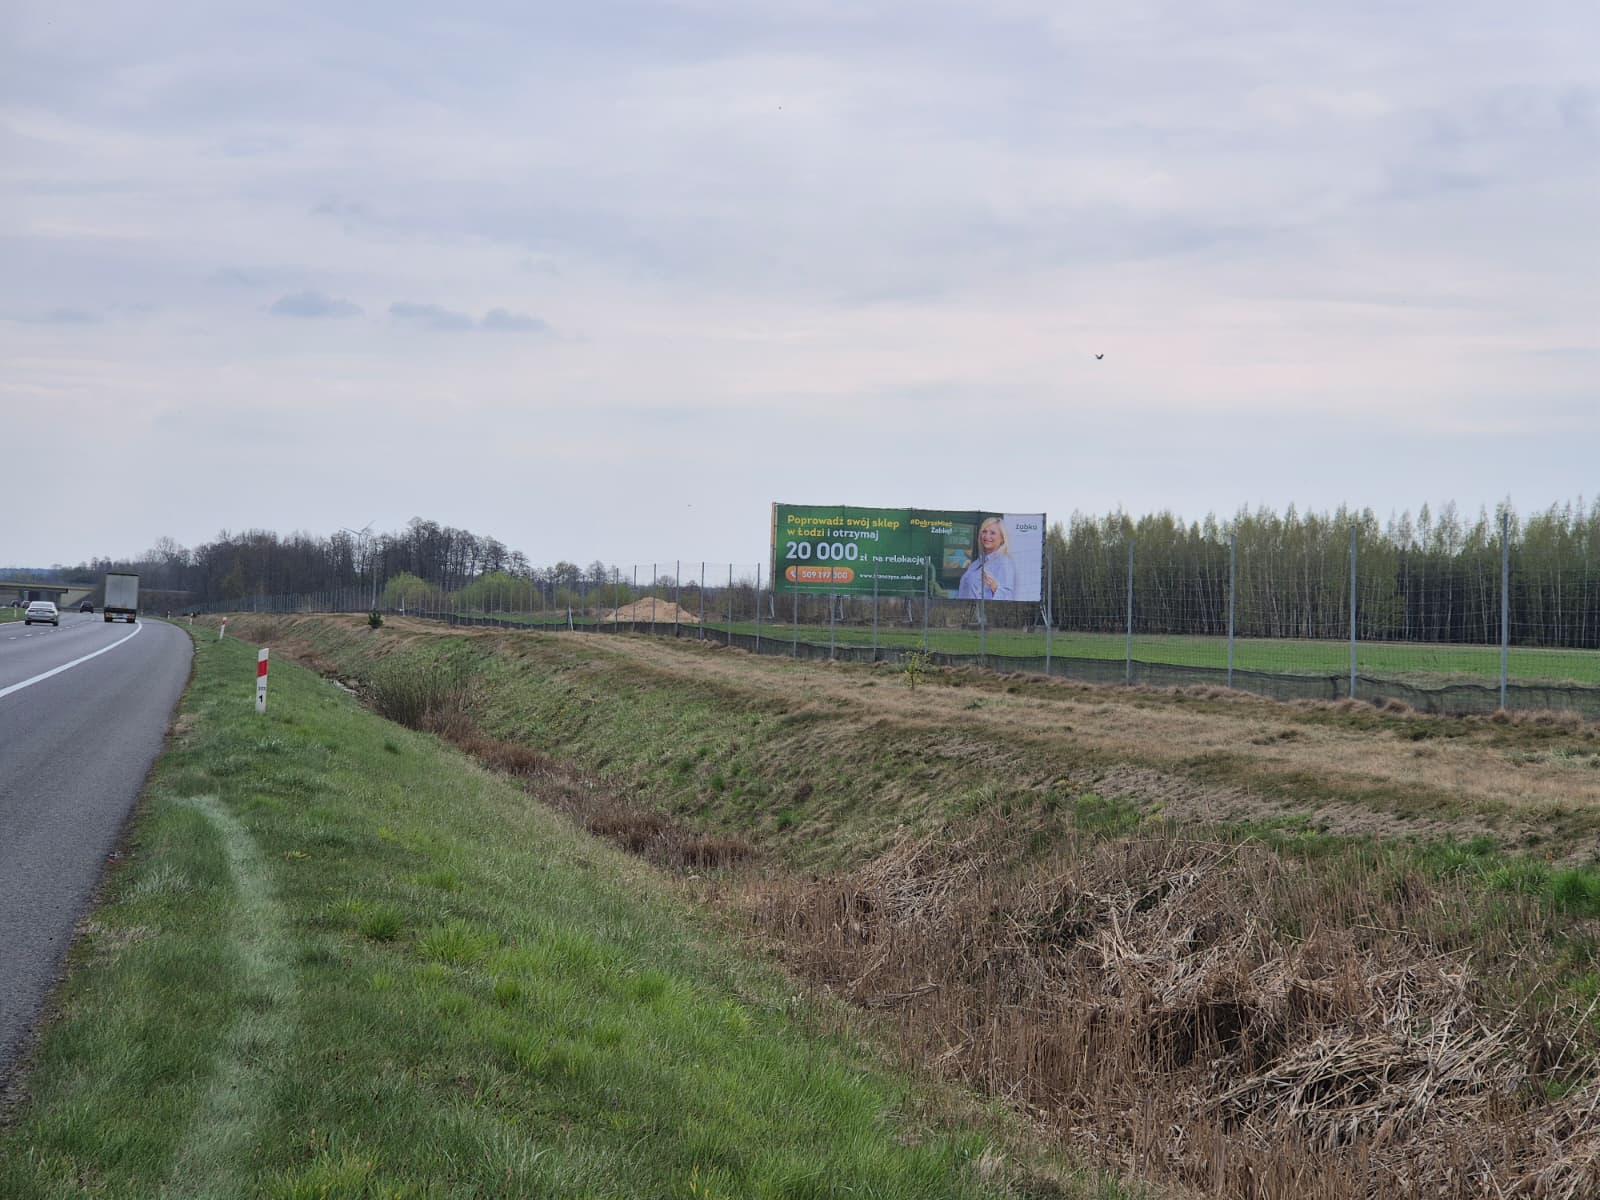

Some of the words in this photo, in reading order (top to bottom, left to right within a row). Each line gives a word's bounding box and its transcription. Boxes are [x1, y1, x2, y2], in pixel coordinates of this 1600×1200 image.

[787, 514, 844, 527] Poprowadź
[847, 517, 870, 529] swój
[872, 518, 900, 531] sklep
[787, 528, 796, 536] w
[798, 527, 825, 537] Łodzi
[827, 528, 831, 537] i
[833, 529, 879, 542] otrzymaj
[785, 541, 812, 559] 20
[816, 542, 859, 561] 000
